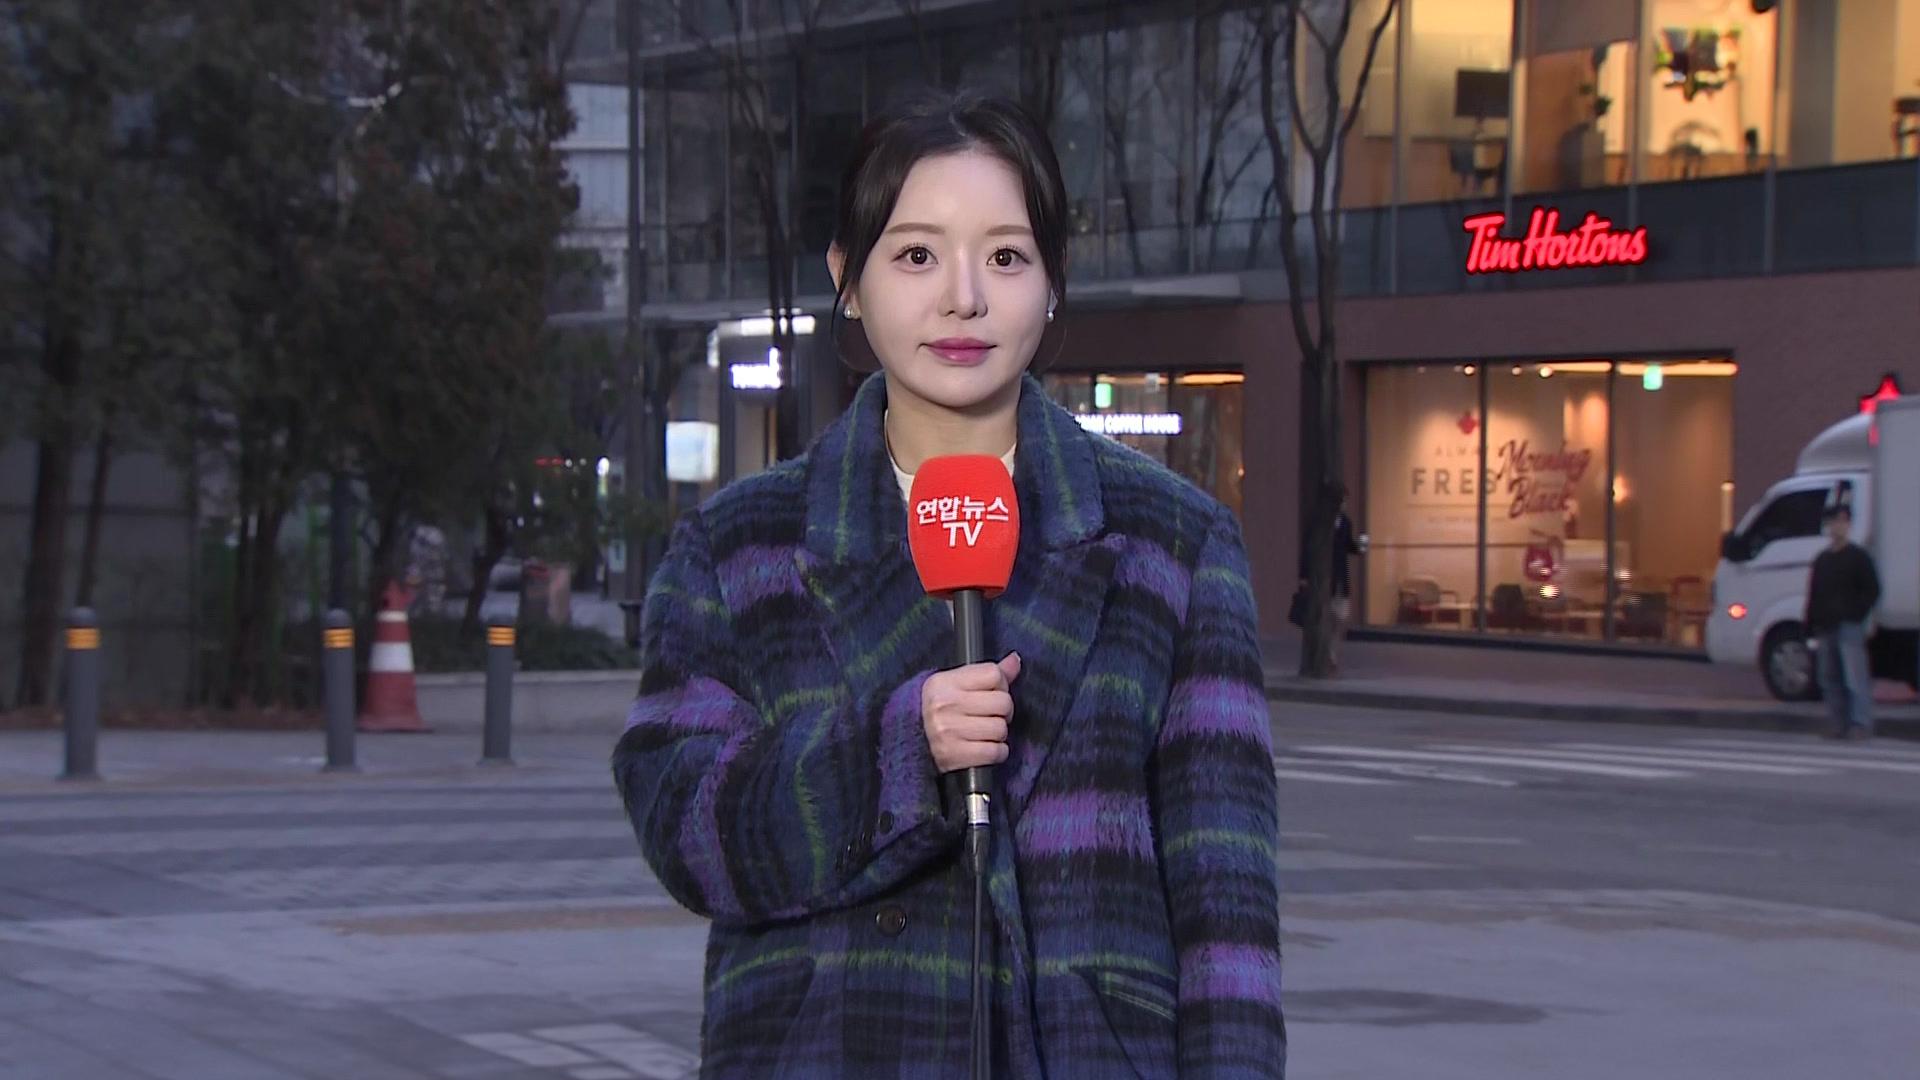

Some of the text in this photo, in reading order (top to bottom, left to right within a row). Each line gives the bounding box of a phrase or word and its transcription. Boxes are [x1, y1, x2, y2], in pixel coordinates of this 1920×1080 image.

[1463, 206, 1649, 273] Tim Hortons
[1411, 467, 1499, 495] FRES
[915, 495, 1009, 525] 연합뉴스
[942, 521, 984, 548] TV
